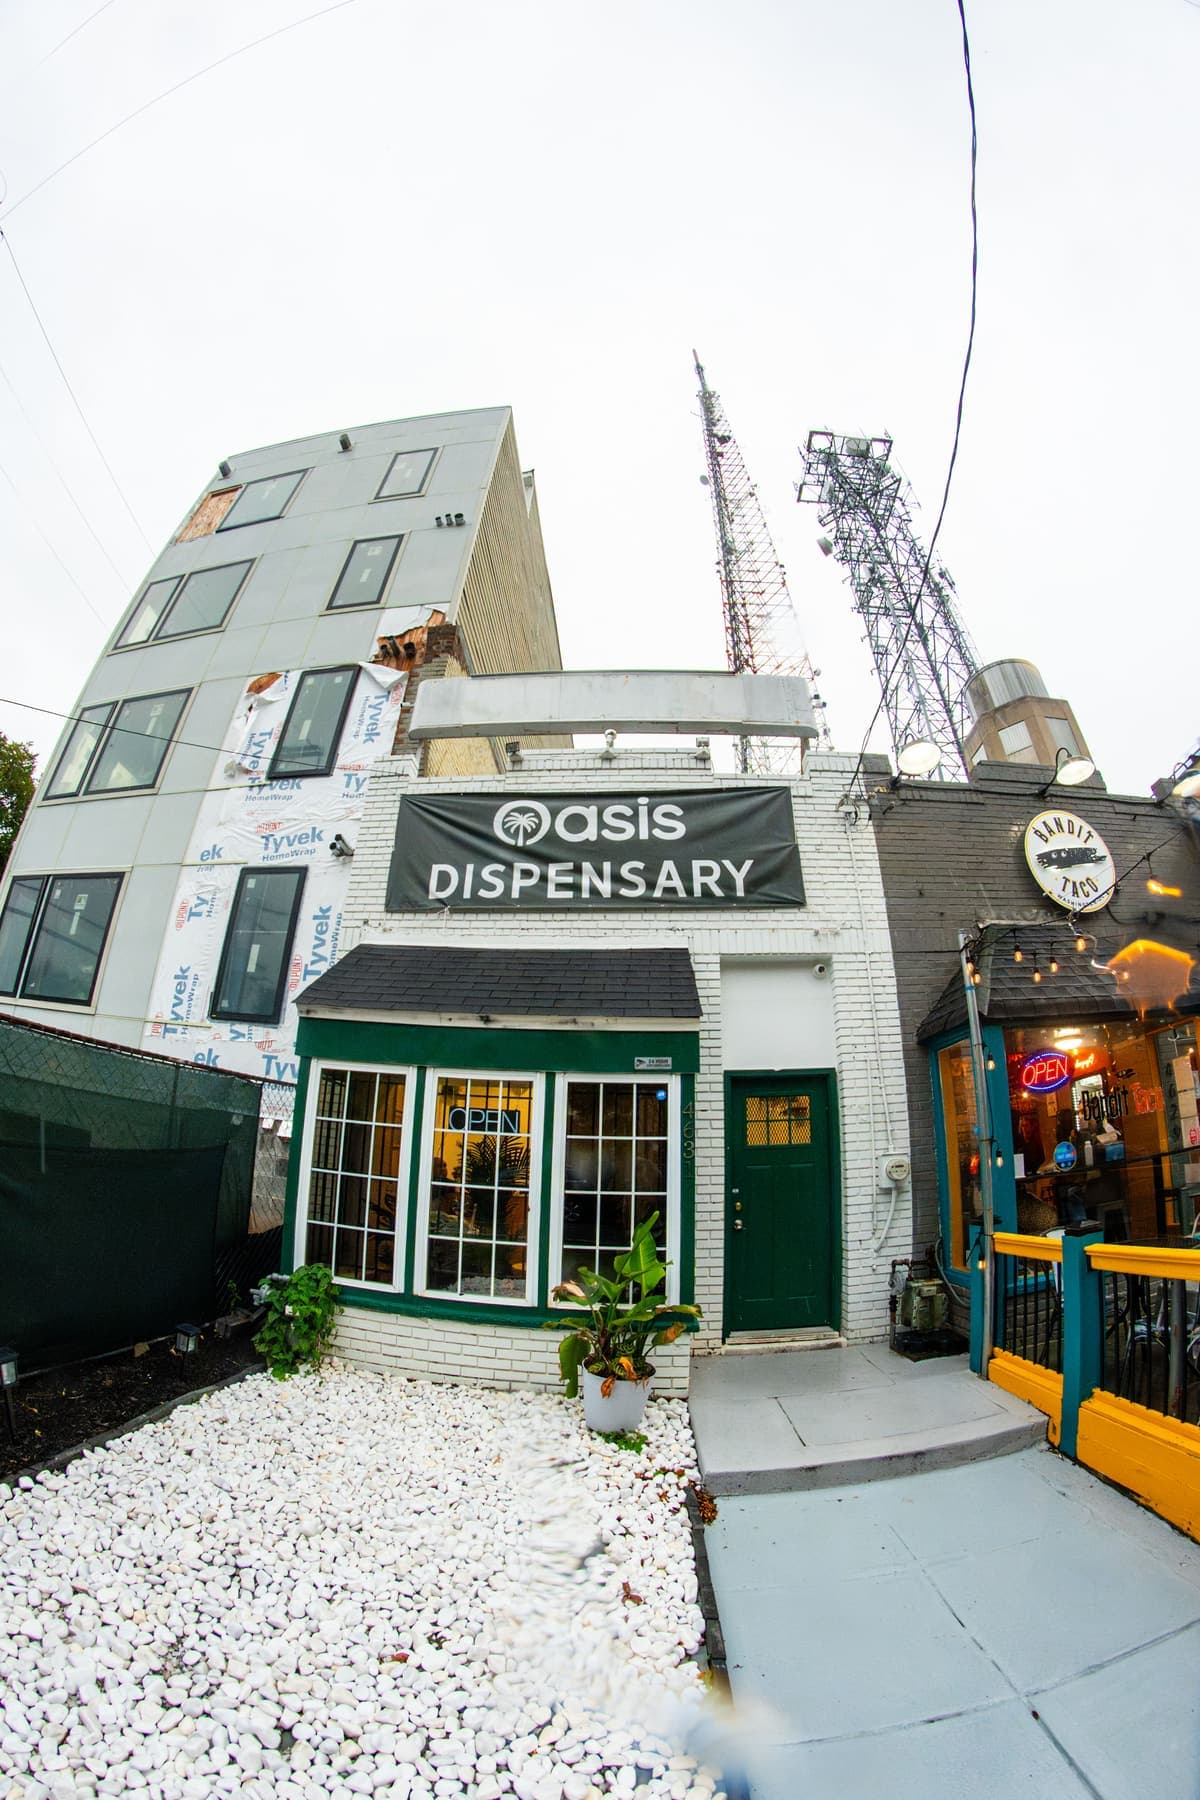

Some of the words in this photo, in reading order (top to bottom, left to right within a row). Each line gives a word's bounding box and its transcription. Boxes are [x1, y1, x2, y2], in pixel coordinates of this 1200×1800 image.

[363, 690, 391, 744] Tyvek
[249, 727, 274, 770] Tyve
[260, 826, 324, 853] Tyvek
[1032, 817, 1094, 844] BANDIT
[262, 847, 316, 862] HomeWrap
[428, 859, 754, 900] DISPENSARY
[1062, 876, 1098, 898] TACO
[302, 905, 332, 981] Tyvek
[163, 964, 191, 1039] Tyvek
[181, 973, 199, 1035] HmeWrap
[1022, 1056, 1068, 1086] OPEN
[449, 1108, 519, 1134] OPEN
[1081, 1085, 1129, 1121] Bandit
[1130, 1082, 1166, 1114] Taco
